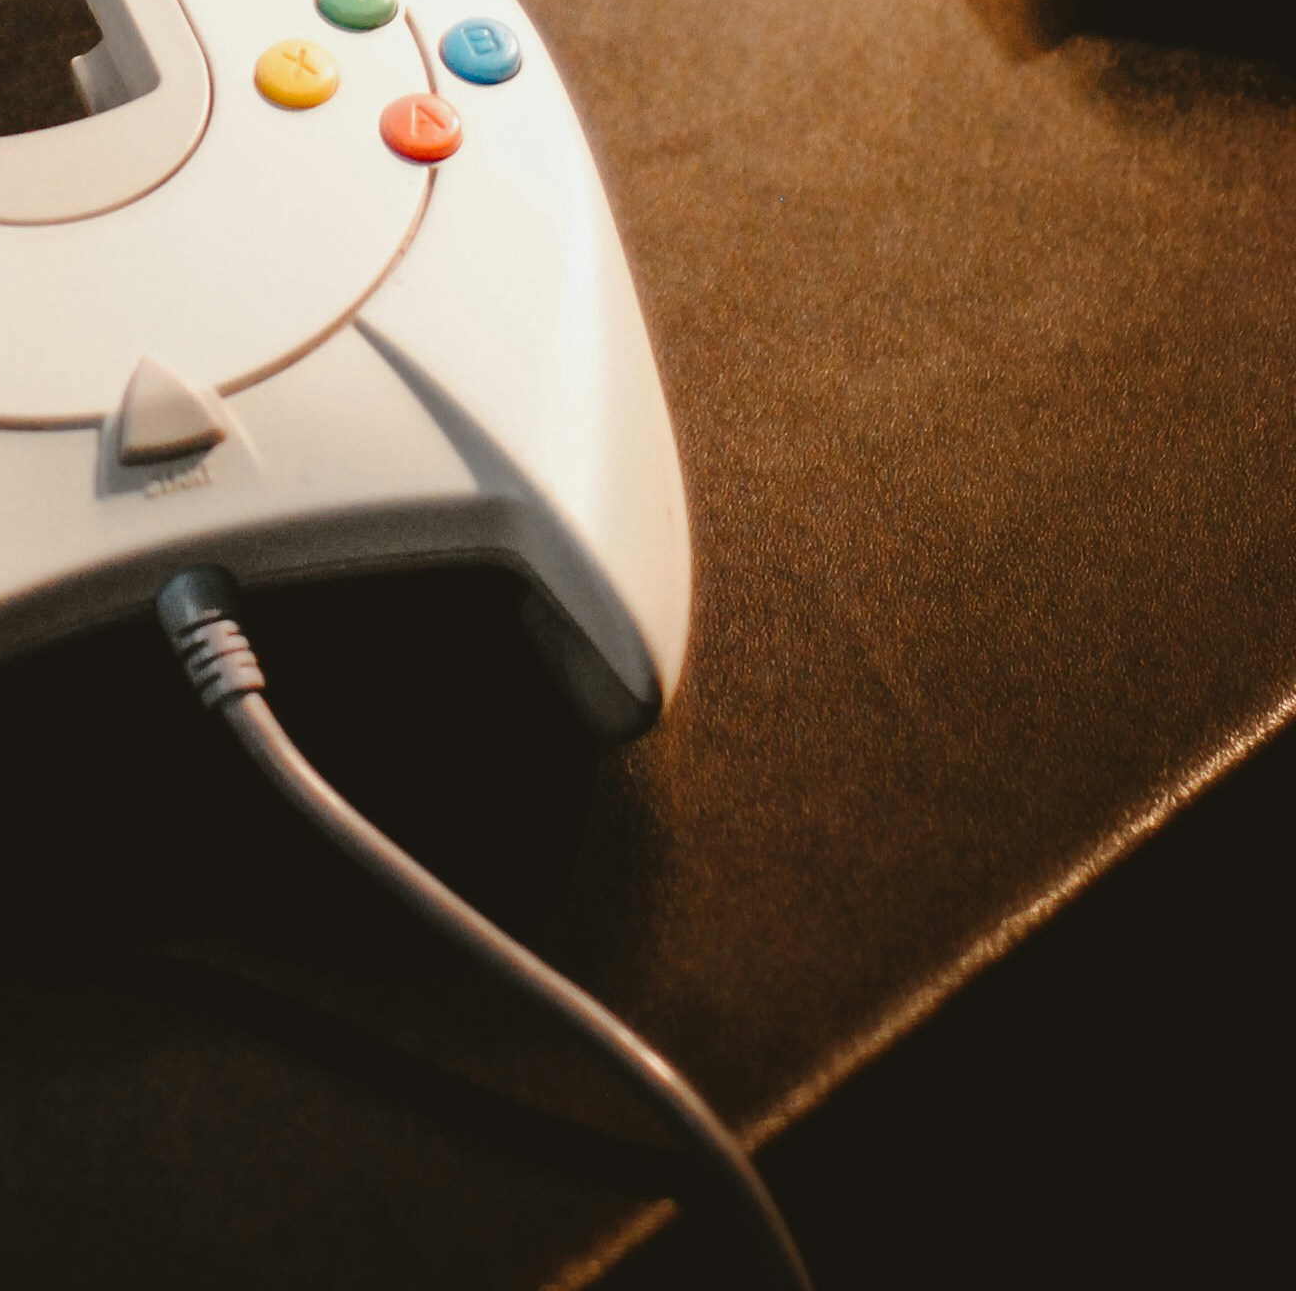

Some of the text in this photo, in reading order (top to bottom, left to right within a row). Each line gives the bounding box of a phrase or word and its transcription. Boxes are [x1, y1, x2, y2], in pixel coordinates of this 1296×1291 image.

[461, 24, 502, 57] B
[281, 47, 318, 80] X
[409, 100, 447, 138] A
